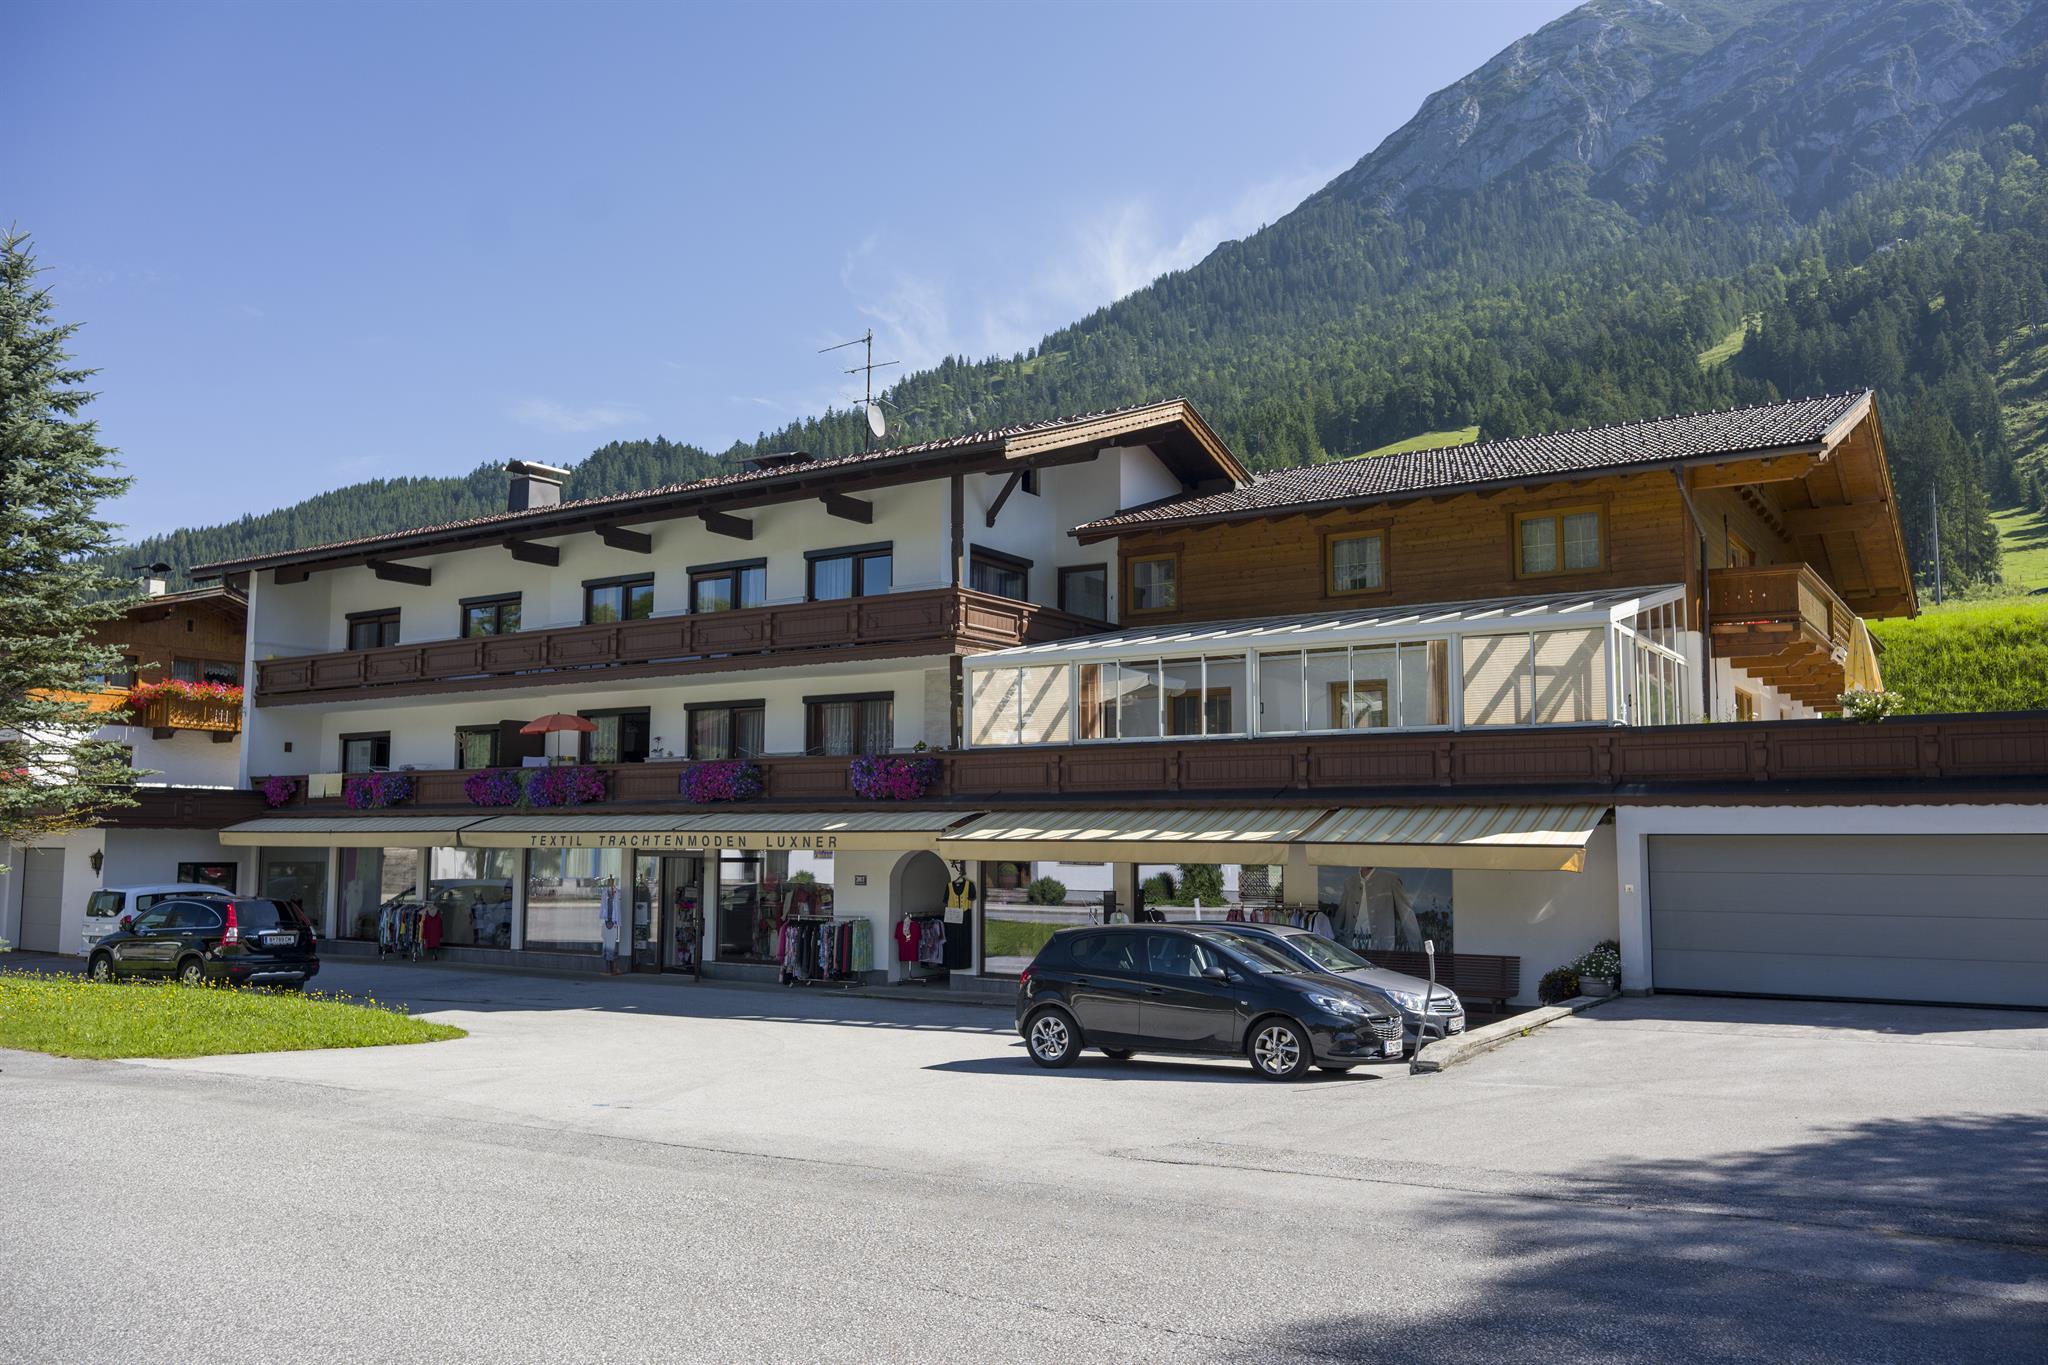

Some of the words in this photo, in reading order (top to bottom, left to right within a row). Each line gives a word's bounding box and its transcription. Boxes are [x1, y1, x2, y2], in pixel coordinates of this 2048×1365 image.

[530, 835, 582, 847] TEXTIL
[599, 835, 747, 847] TRACHTENMODEN
[766, 835, 838, 848] LUXNER
